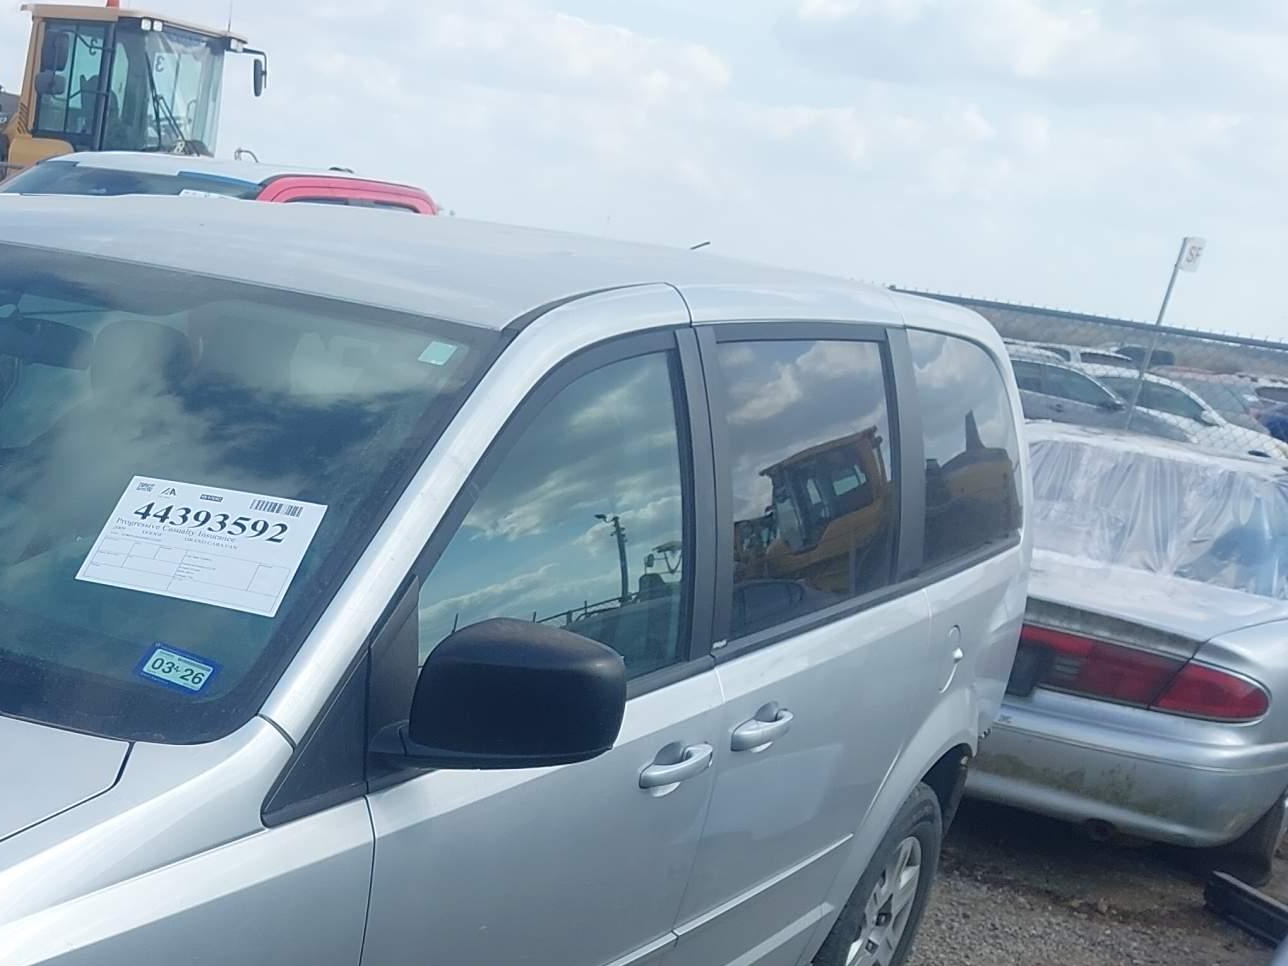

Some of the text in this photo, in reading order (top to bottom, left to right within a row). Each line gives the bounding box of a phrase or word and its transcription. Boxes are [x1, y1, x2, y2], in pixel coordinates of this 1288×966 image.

[116, 517, 163, 531] Progressive
[198, 530, 237, 543] Insurance
[133, 501, 289, 543] 44393592
[151, 657, 175, 674] 03
[179, 668, 205, 685] 26
